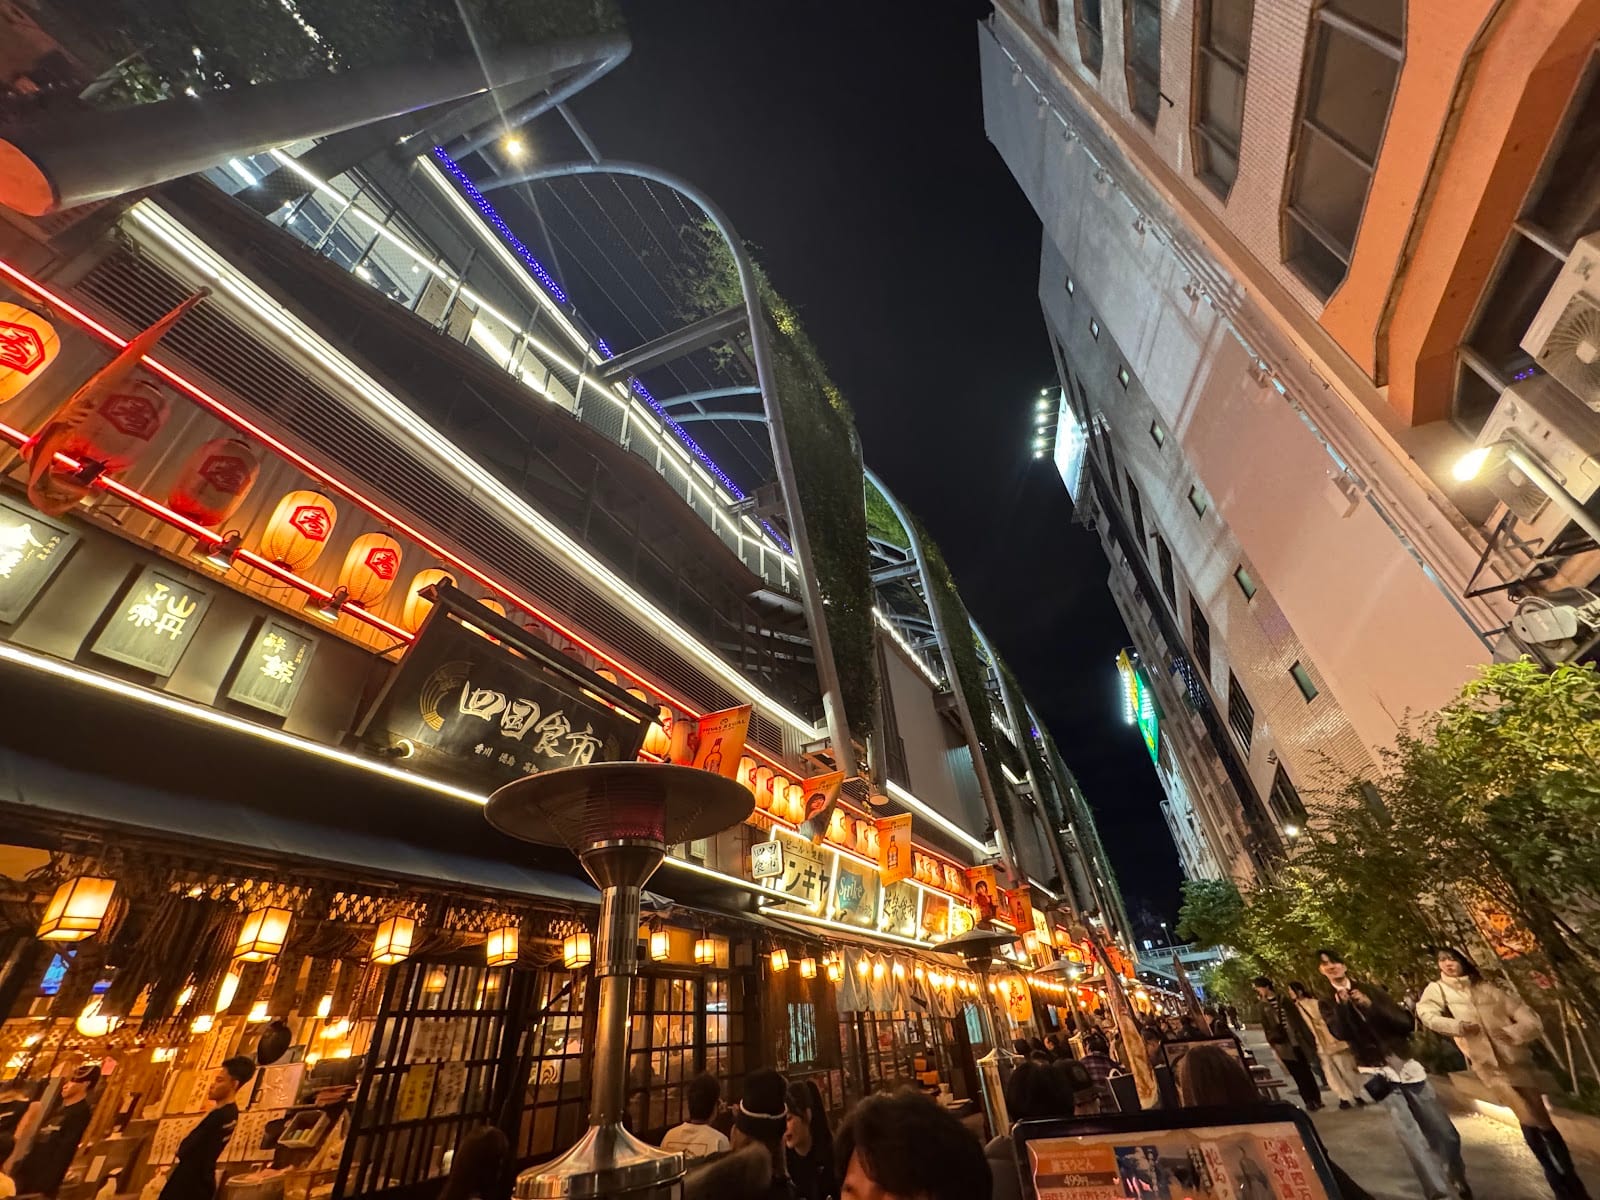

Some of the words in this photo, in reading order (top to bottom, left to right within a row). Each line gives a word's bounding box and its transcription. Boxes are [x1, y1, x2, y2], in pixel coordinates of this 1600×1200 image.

[784, 860, 831, 902] ンキヤ
[839, 877, 863, 901] Strike
